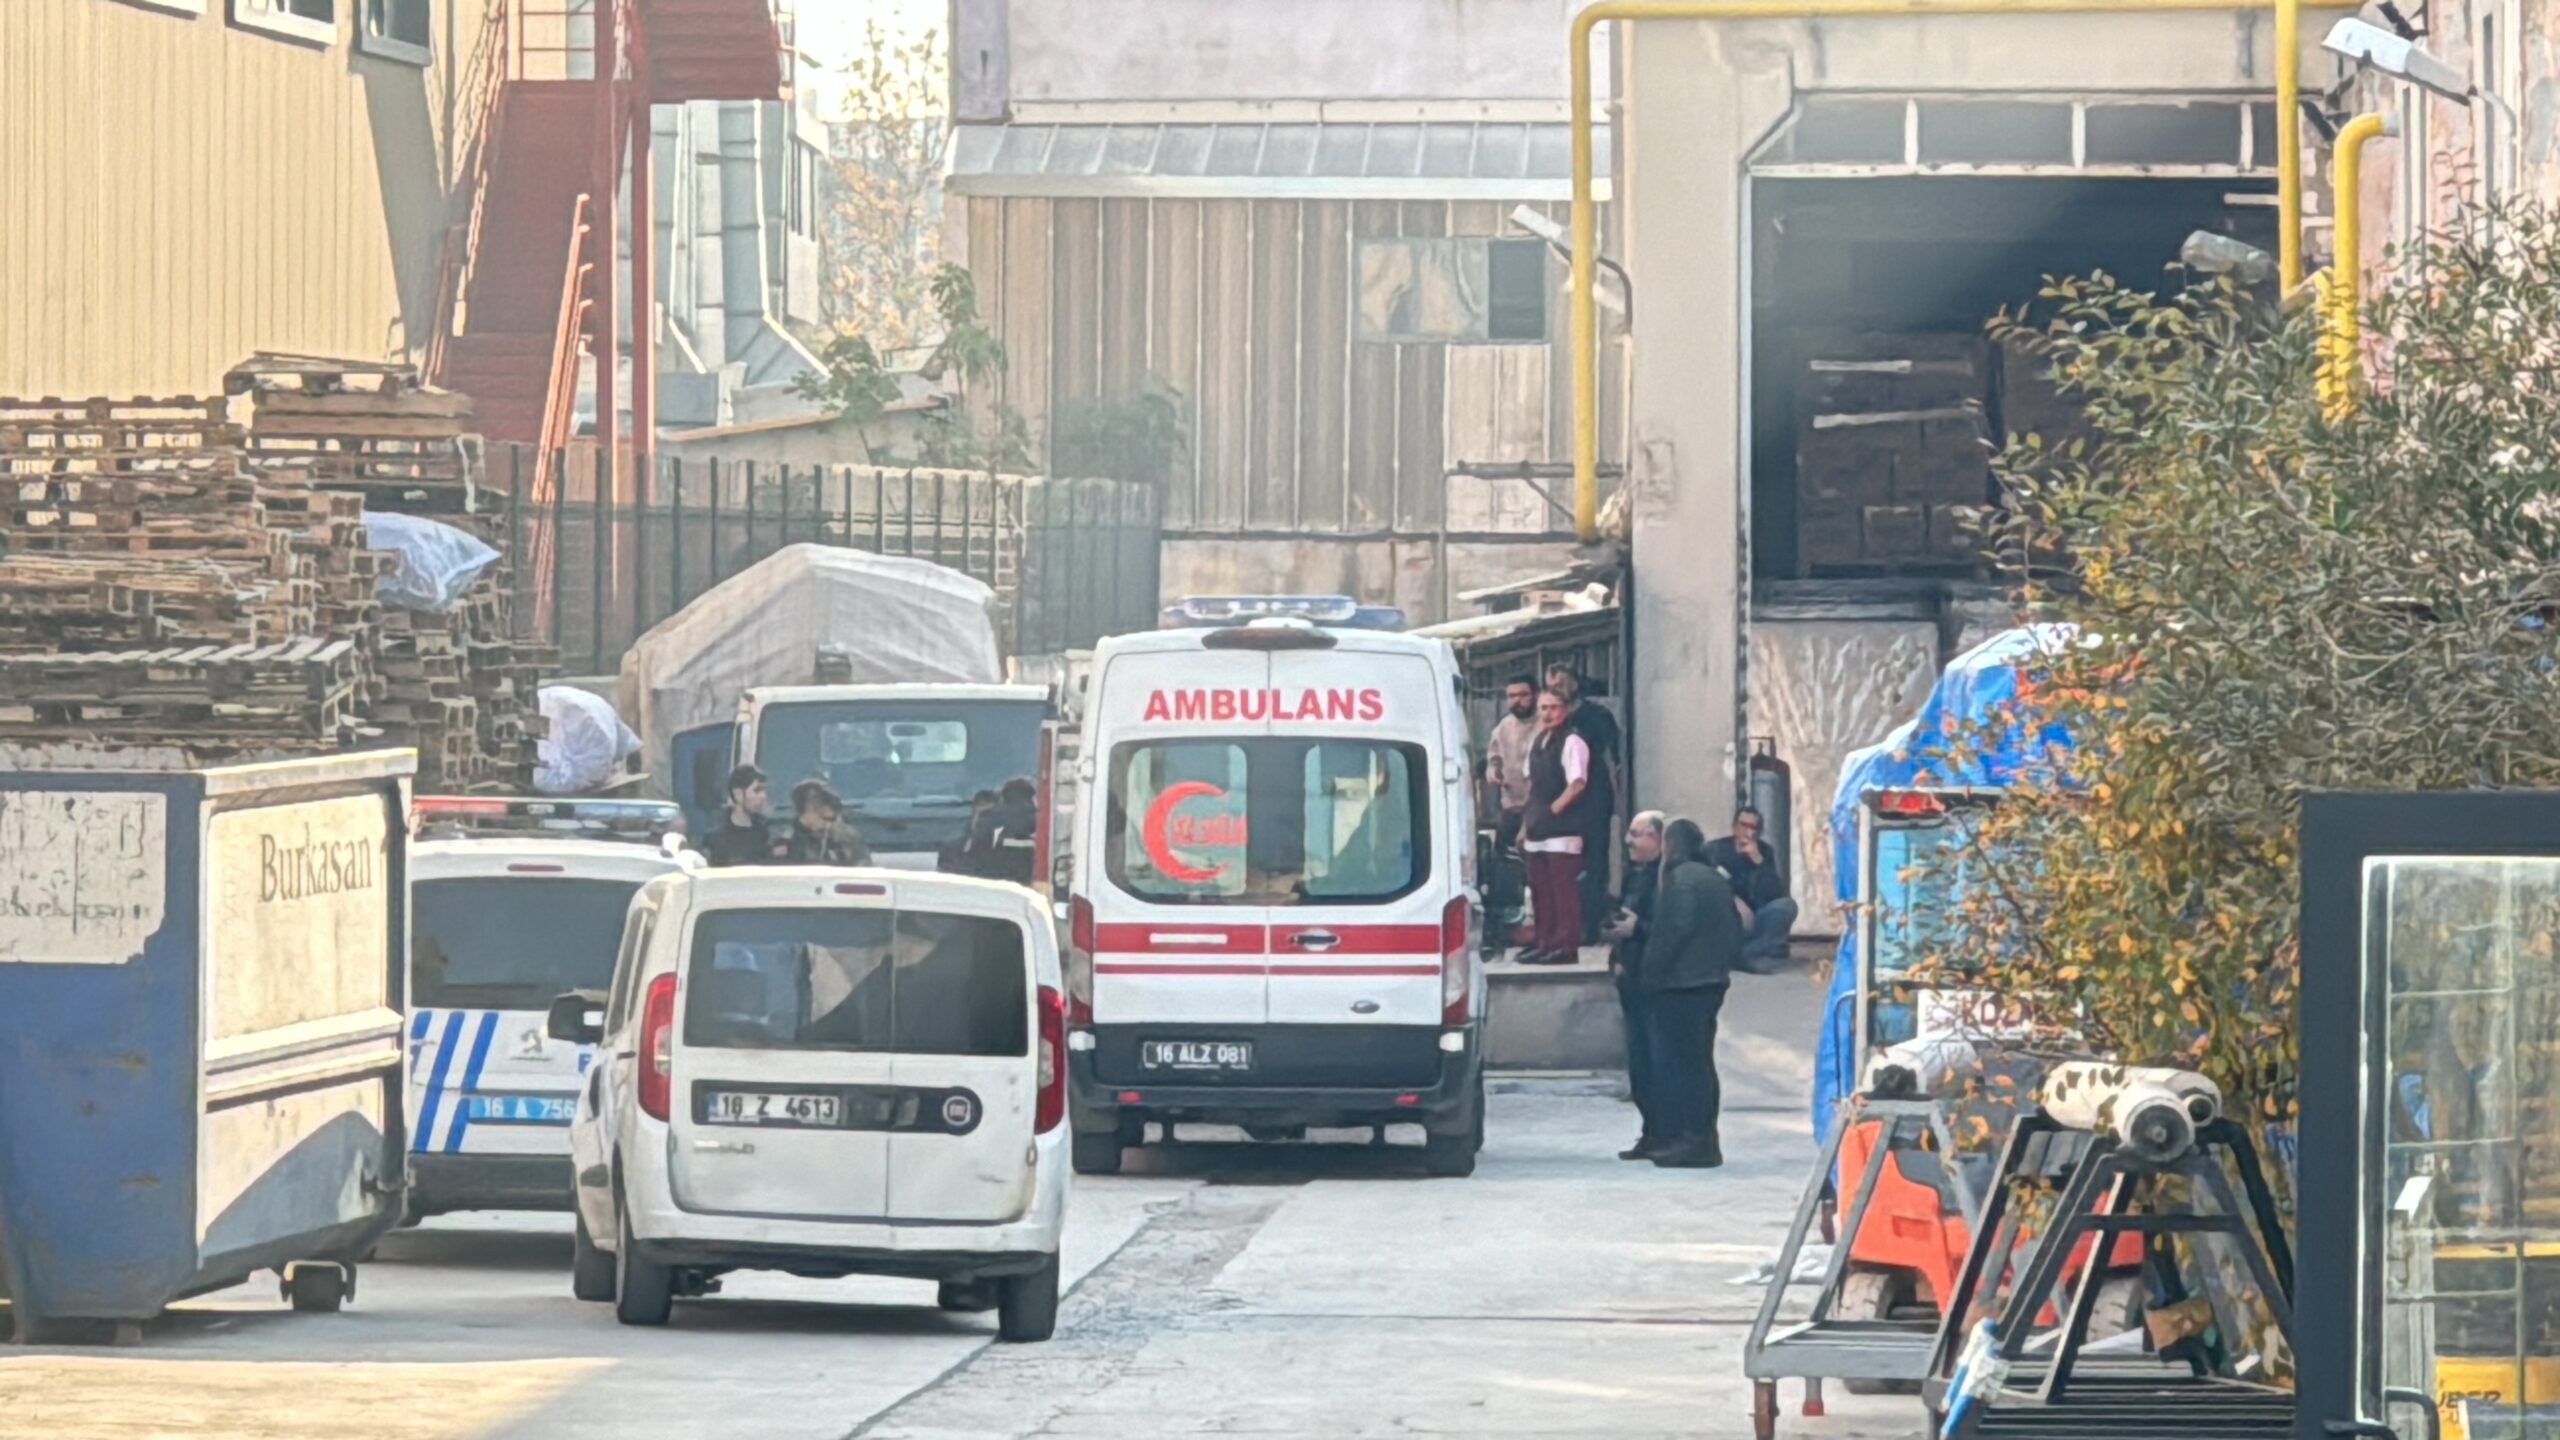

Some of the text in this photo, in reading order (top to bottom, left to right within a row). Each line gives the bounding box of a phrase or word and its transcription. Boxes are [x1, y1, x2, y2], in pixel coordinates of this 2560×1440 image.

[1143, 688, 1384, 722] AMBULANS
[258, 821, 373, 903] Burkasan
[1156, 1044, 1247, 1063] 16 ALZ 081
[482, 1097, 504, 1119] 16
[514, 1097, 530, 1119] A
[757, 1095, 771, 1117] Z
[785, 1097, 835, 1119] 4613
